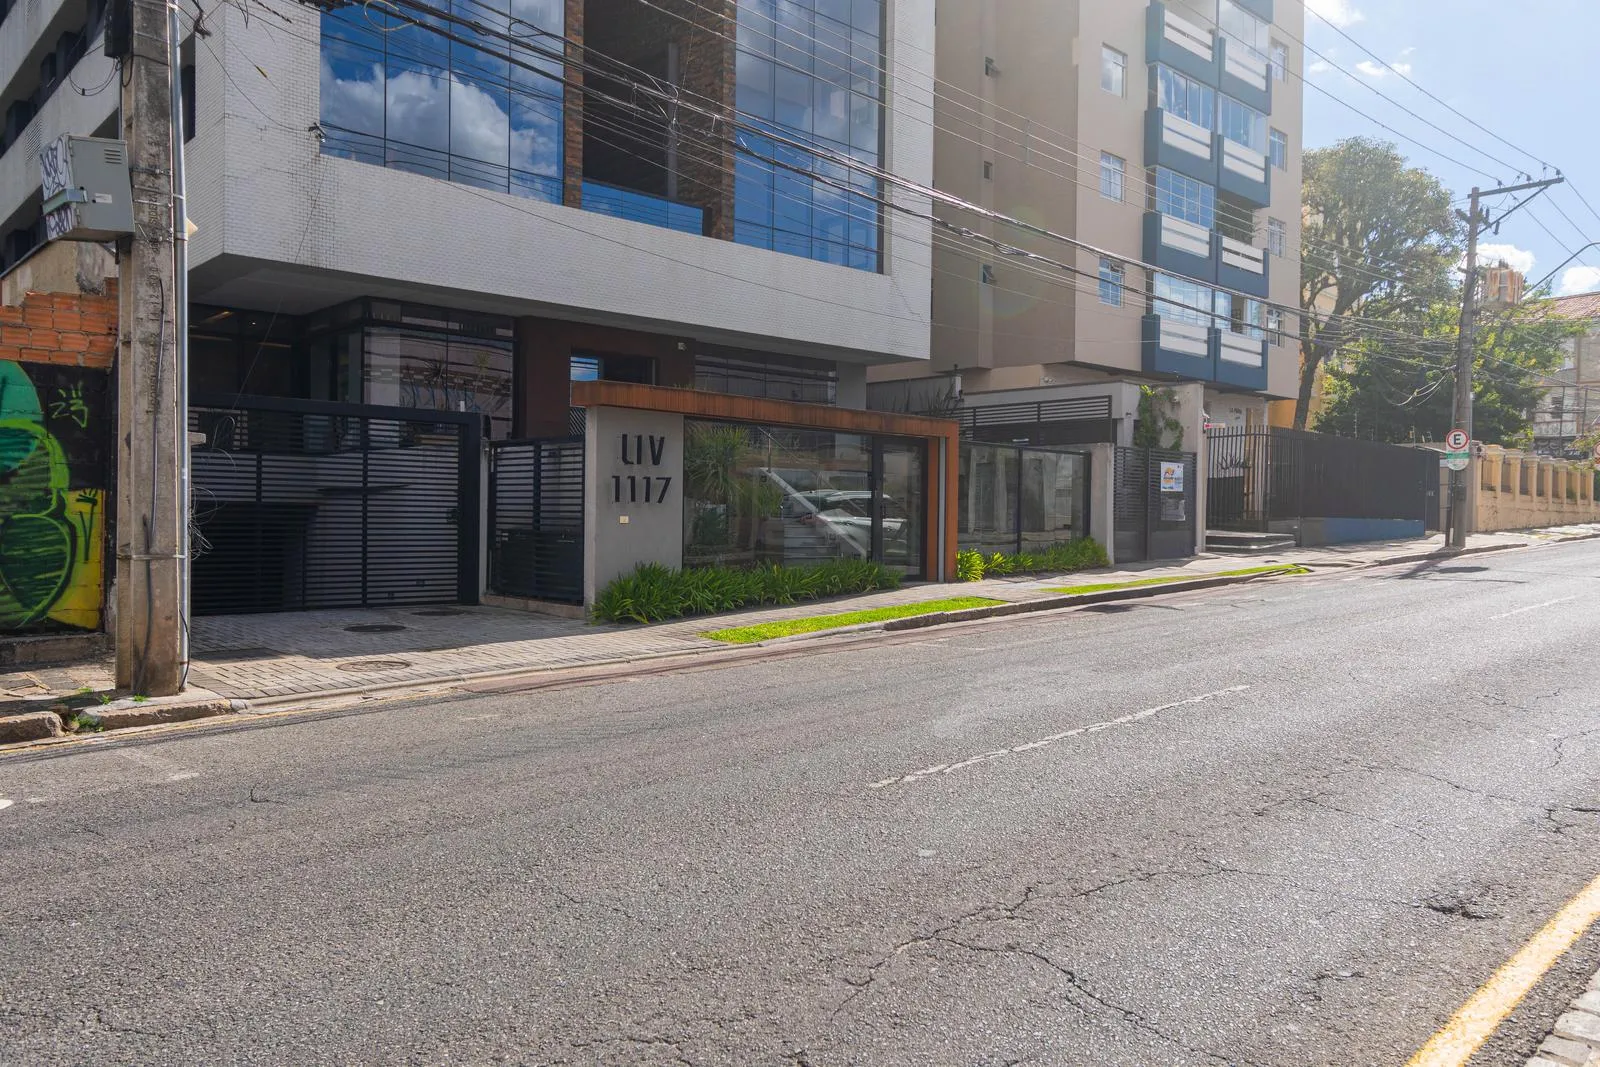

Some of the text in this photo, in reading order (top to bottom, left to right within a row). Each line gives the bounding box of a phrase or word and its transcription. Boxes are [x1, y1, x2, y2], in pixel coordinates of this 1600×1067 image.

[621, 433, 665, 465] LIV
[1453, 433, 1462, 445] E
[611, 475, 672, 504] 1117
